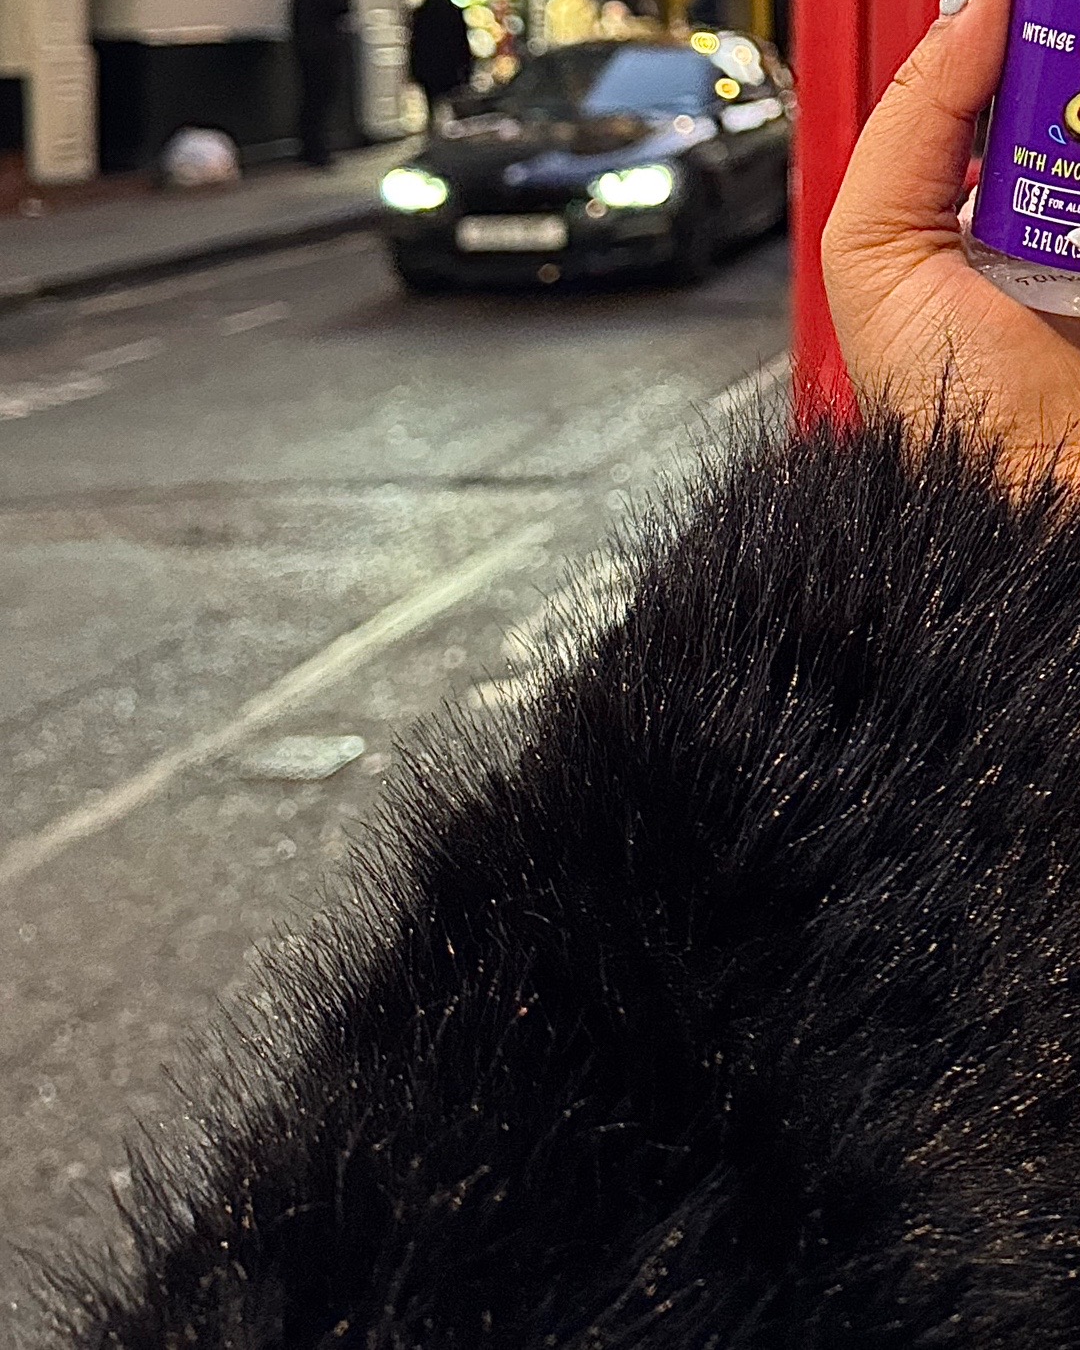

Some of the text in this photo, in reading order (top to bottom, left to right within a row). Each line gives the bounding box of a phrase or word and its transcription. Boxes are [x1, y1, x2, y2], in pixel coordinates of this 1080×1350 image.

[1022, 21, 1075, 52] INTENSE
[1013, 145, 1047, 172] WITH
[1048, 197, 1064, 211] FOR
[1022, 226, 1038, 250] 3.2
[1040, 230, 1052, 253] FL
[1054, 233, 1069, 256] OZ
